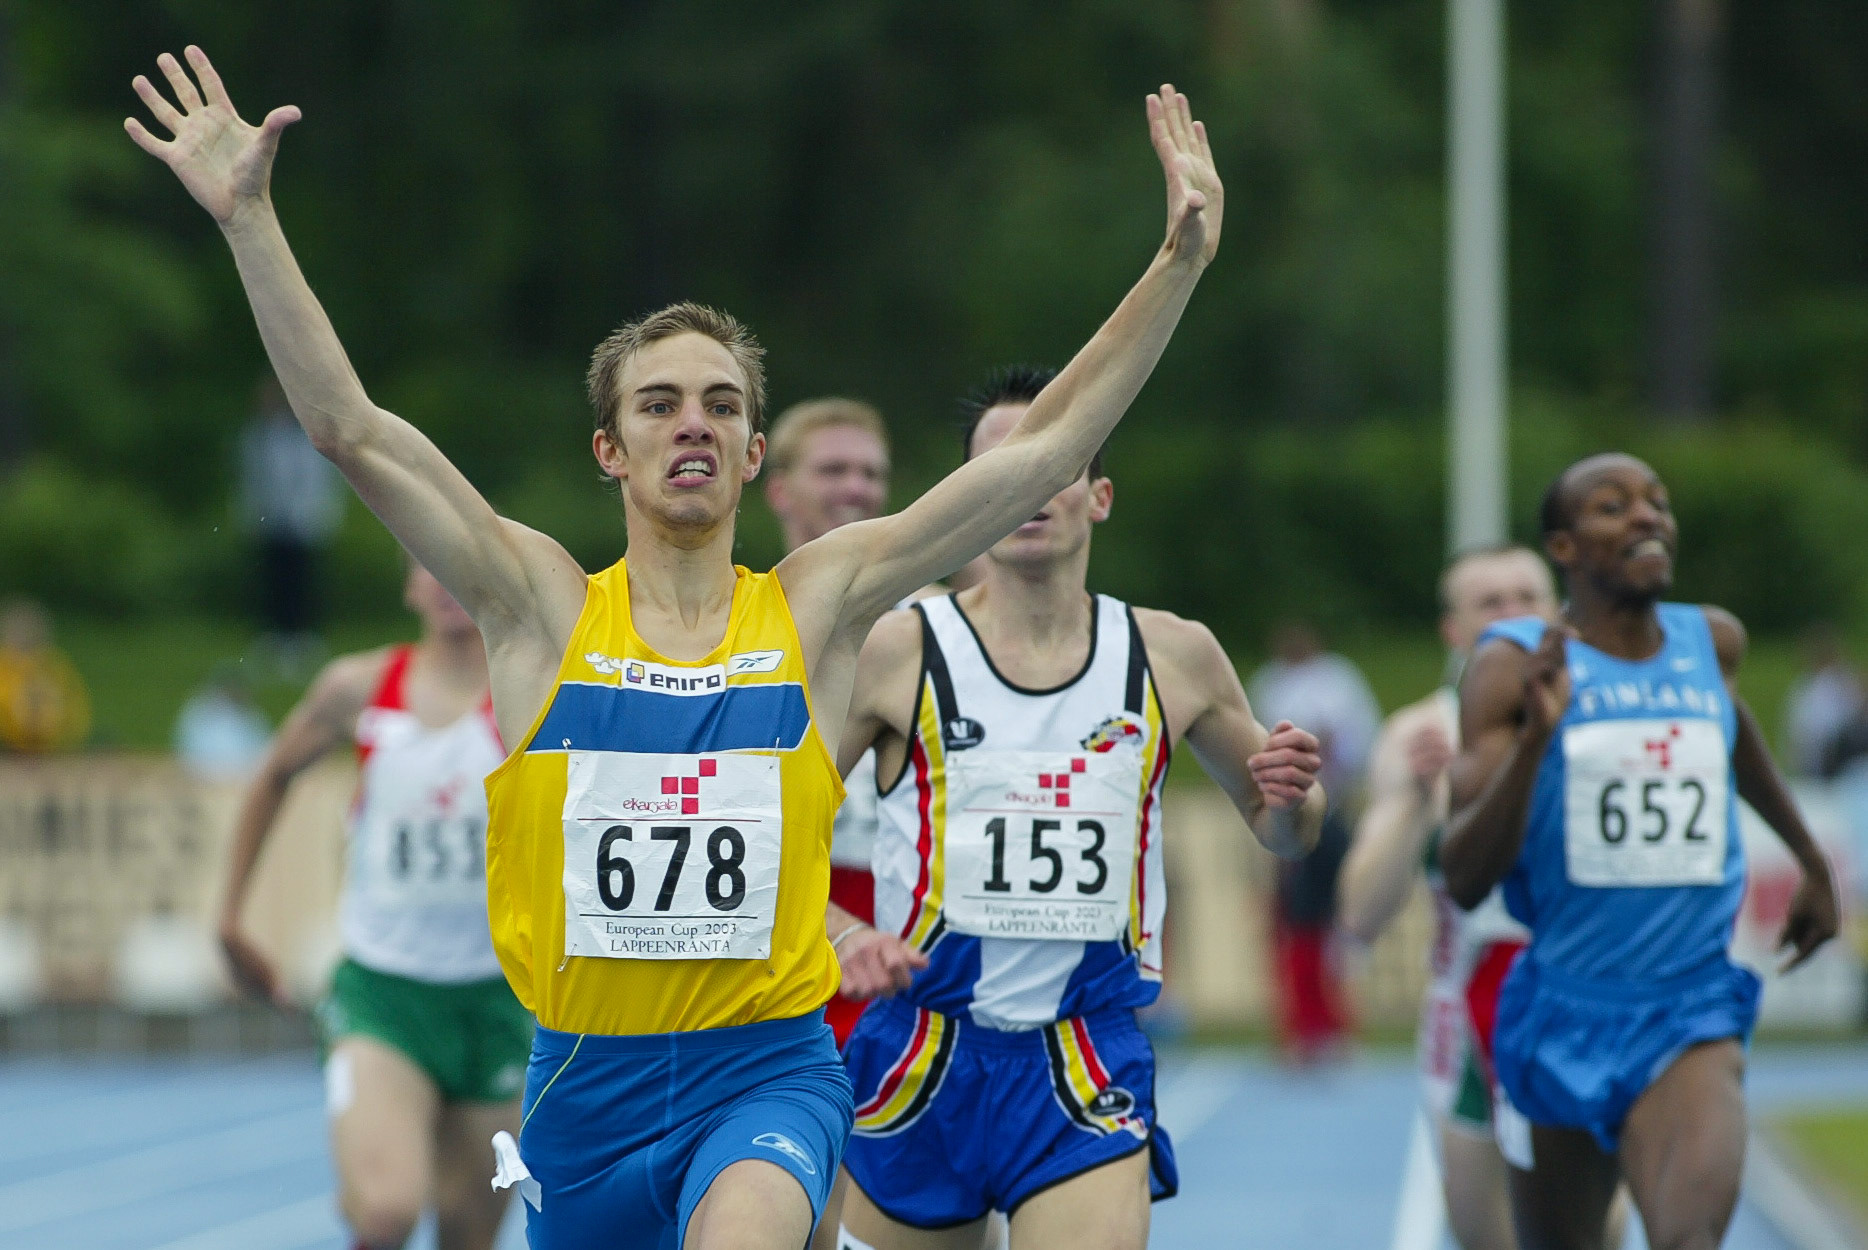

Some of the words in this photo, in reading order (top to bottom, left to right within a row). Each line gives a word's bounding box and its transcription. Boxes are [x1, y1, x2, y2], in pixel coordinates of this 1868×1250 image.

[650, 673, 721, 691] eniro
[1600, 778, 1708, 843] 652
[596, 825, 746, 912] 678
[984, 817, 1108, 895] 153
[605, 921, 664, 938] European
[671, 923, 698, 939] Cup
[704, 923, 737, 935] 2003
[610, 939, 731, 953] LAPPEENRANTA
